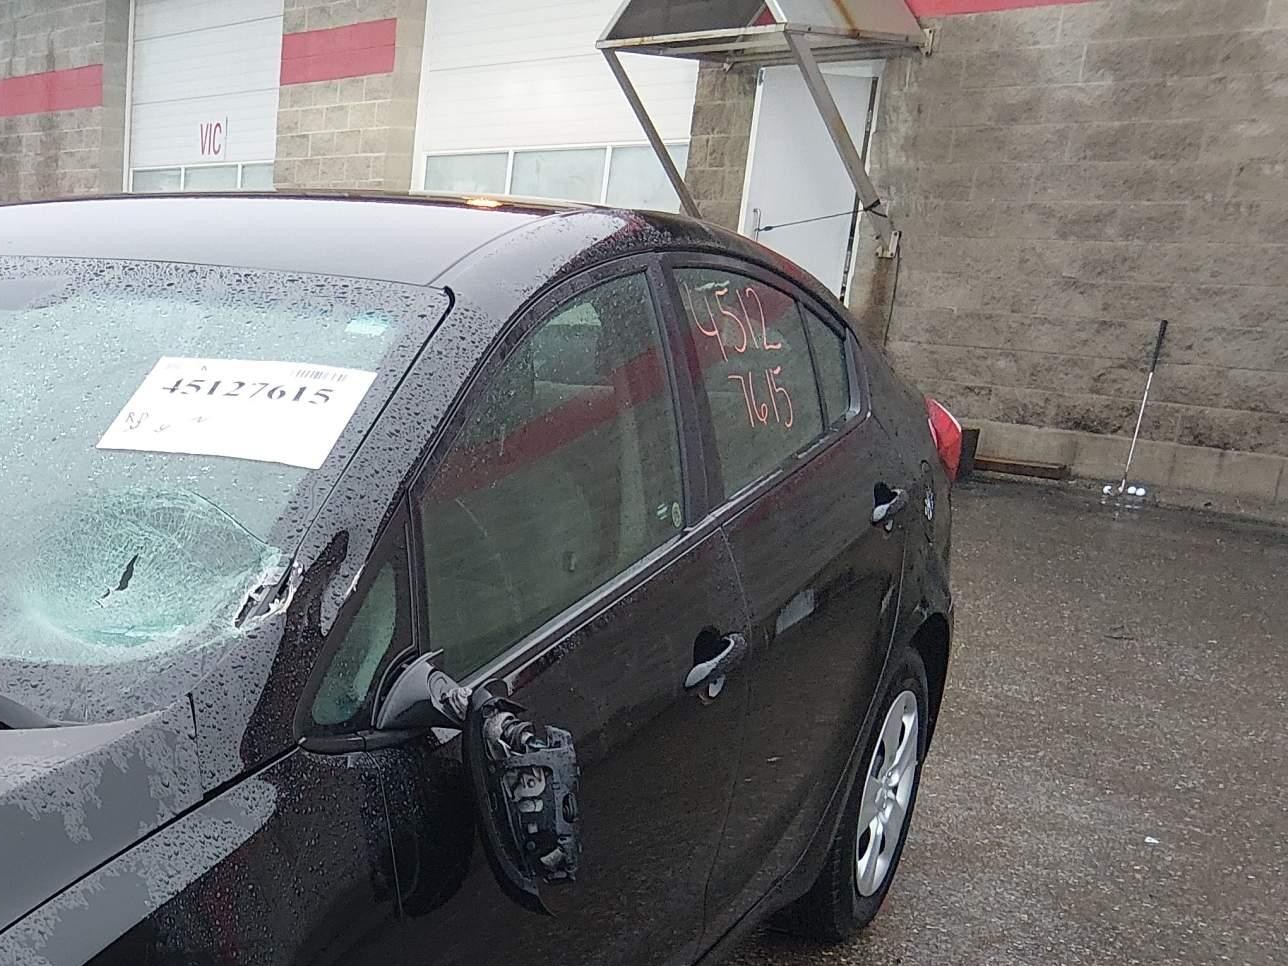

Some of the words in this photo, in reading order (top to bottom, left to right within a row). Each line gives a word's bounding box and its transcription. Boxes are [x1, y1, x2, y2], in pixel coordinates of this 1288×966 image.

[199, 122, 222, 156] VIC
[683, 281, 782, 362] 4512
[162, 378, 335, 405] 45127615
[728, 366, 794, 428] 7615
